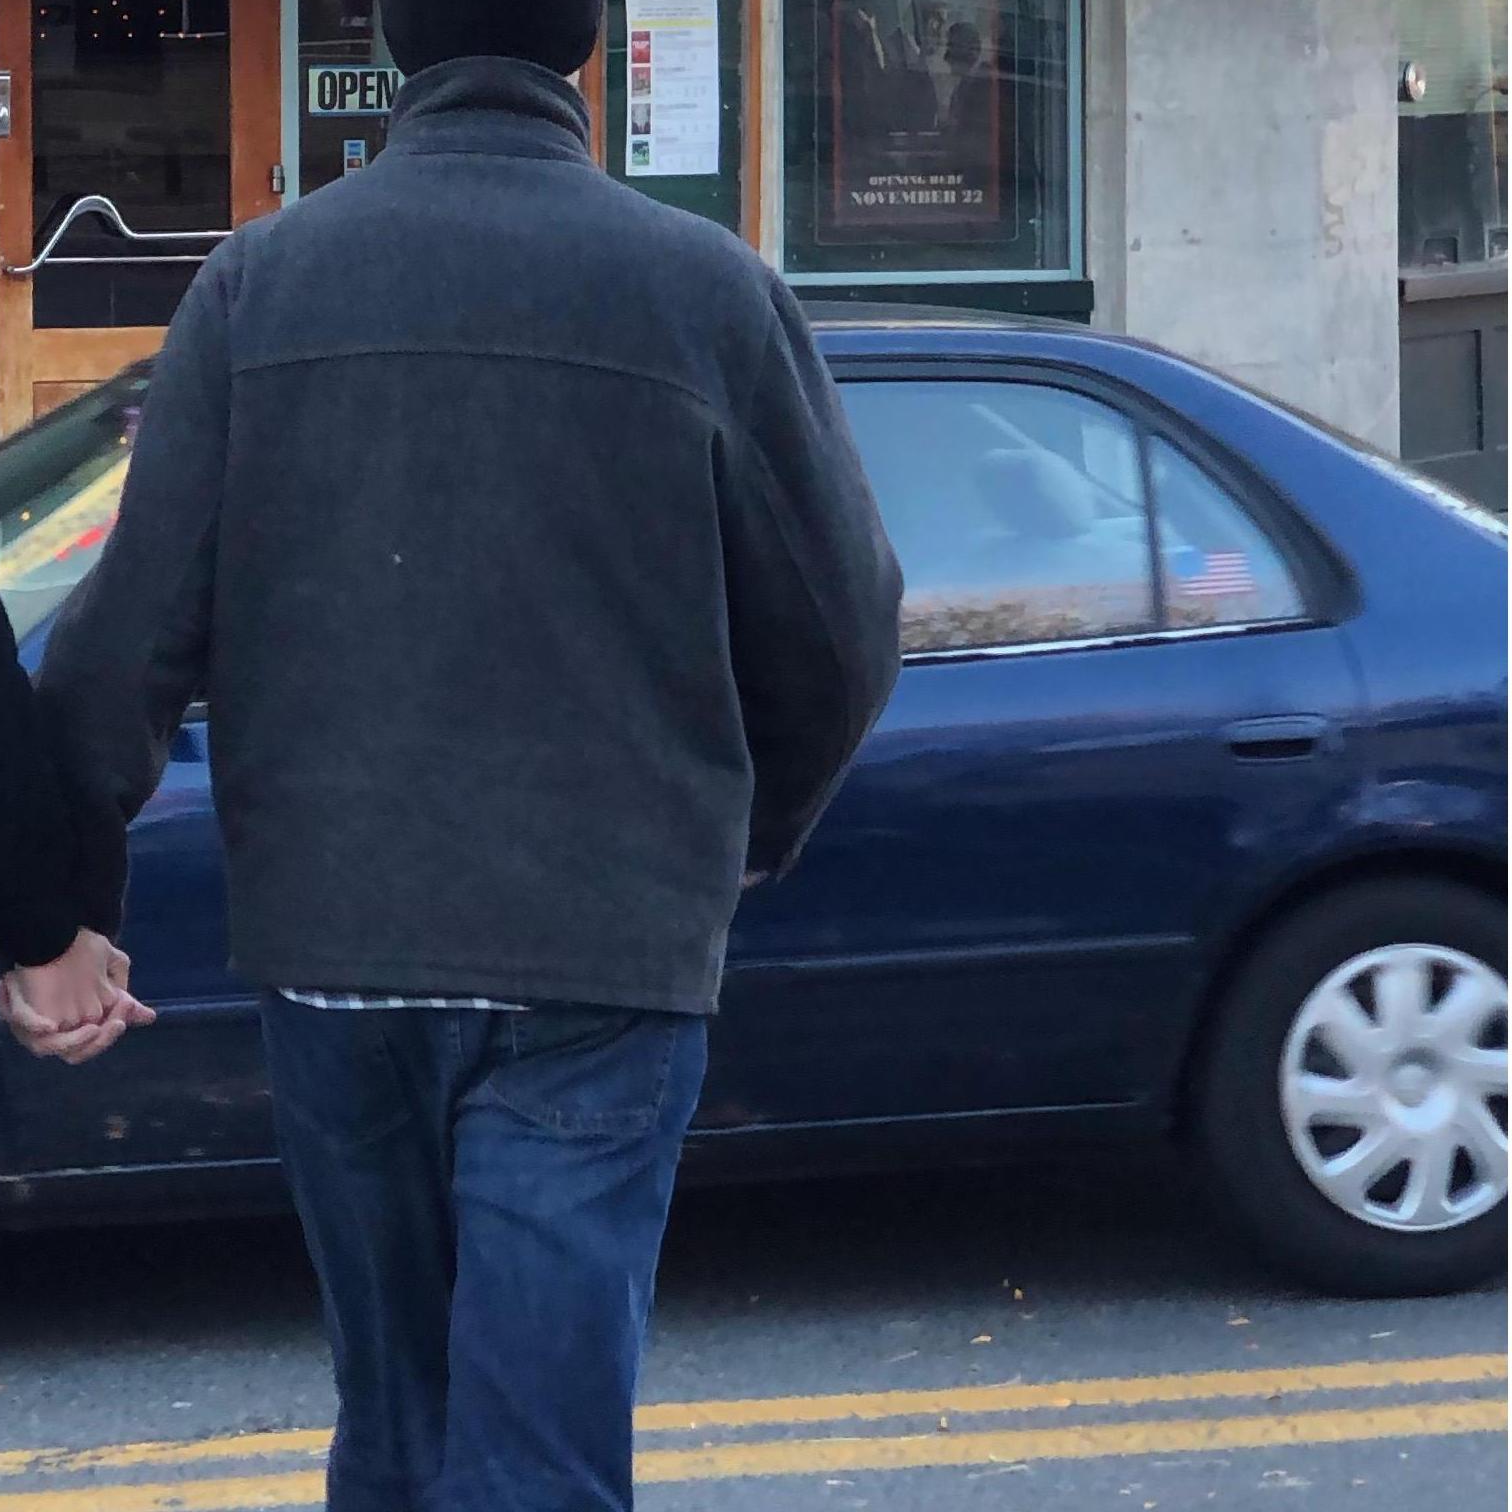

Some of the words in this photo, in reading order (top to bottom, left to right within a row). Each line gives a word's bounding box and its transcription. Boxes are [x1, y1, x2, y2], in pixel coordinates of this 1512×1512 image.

[317, 71, 398, 110] OPEN
[869, 175, 926, 186] OPENING
[850, 190, 956, 206] NOVEMBER
[962, 190, 983, 204] 22
